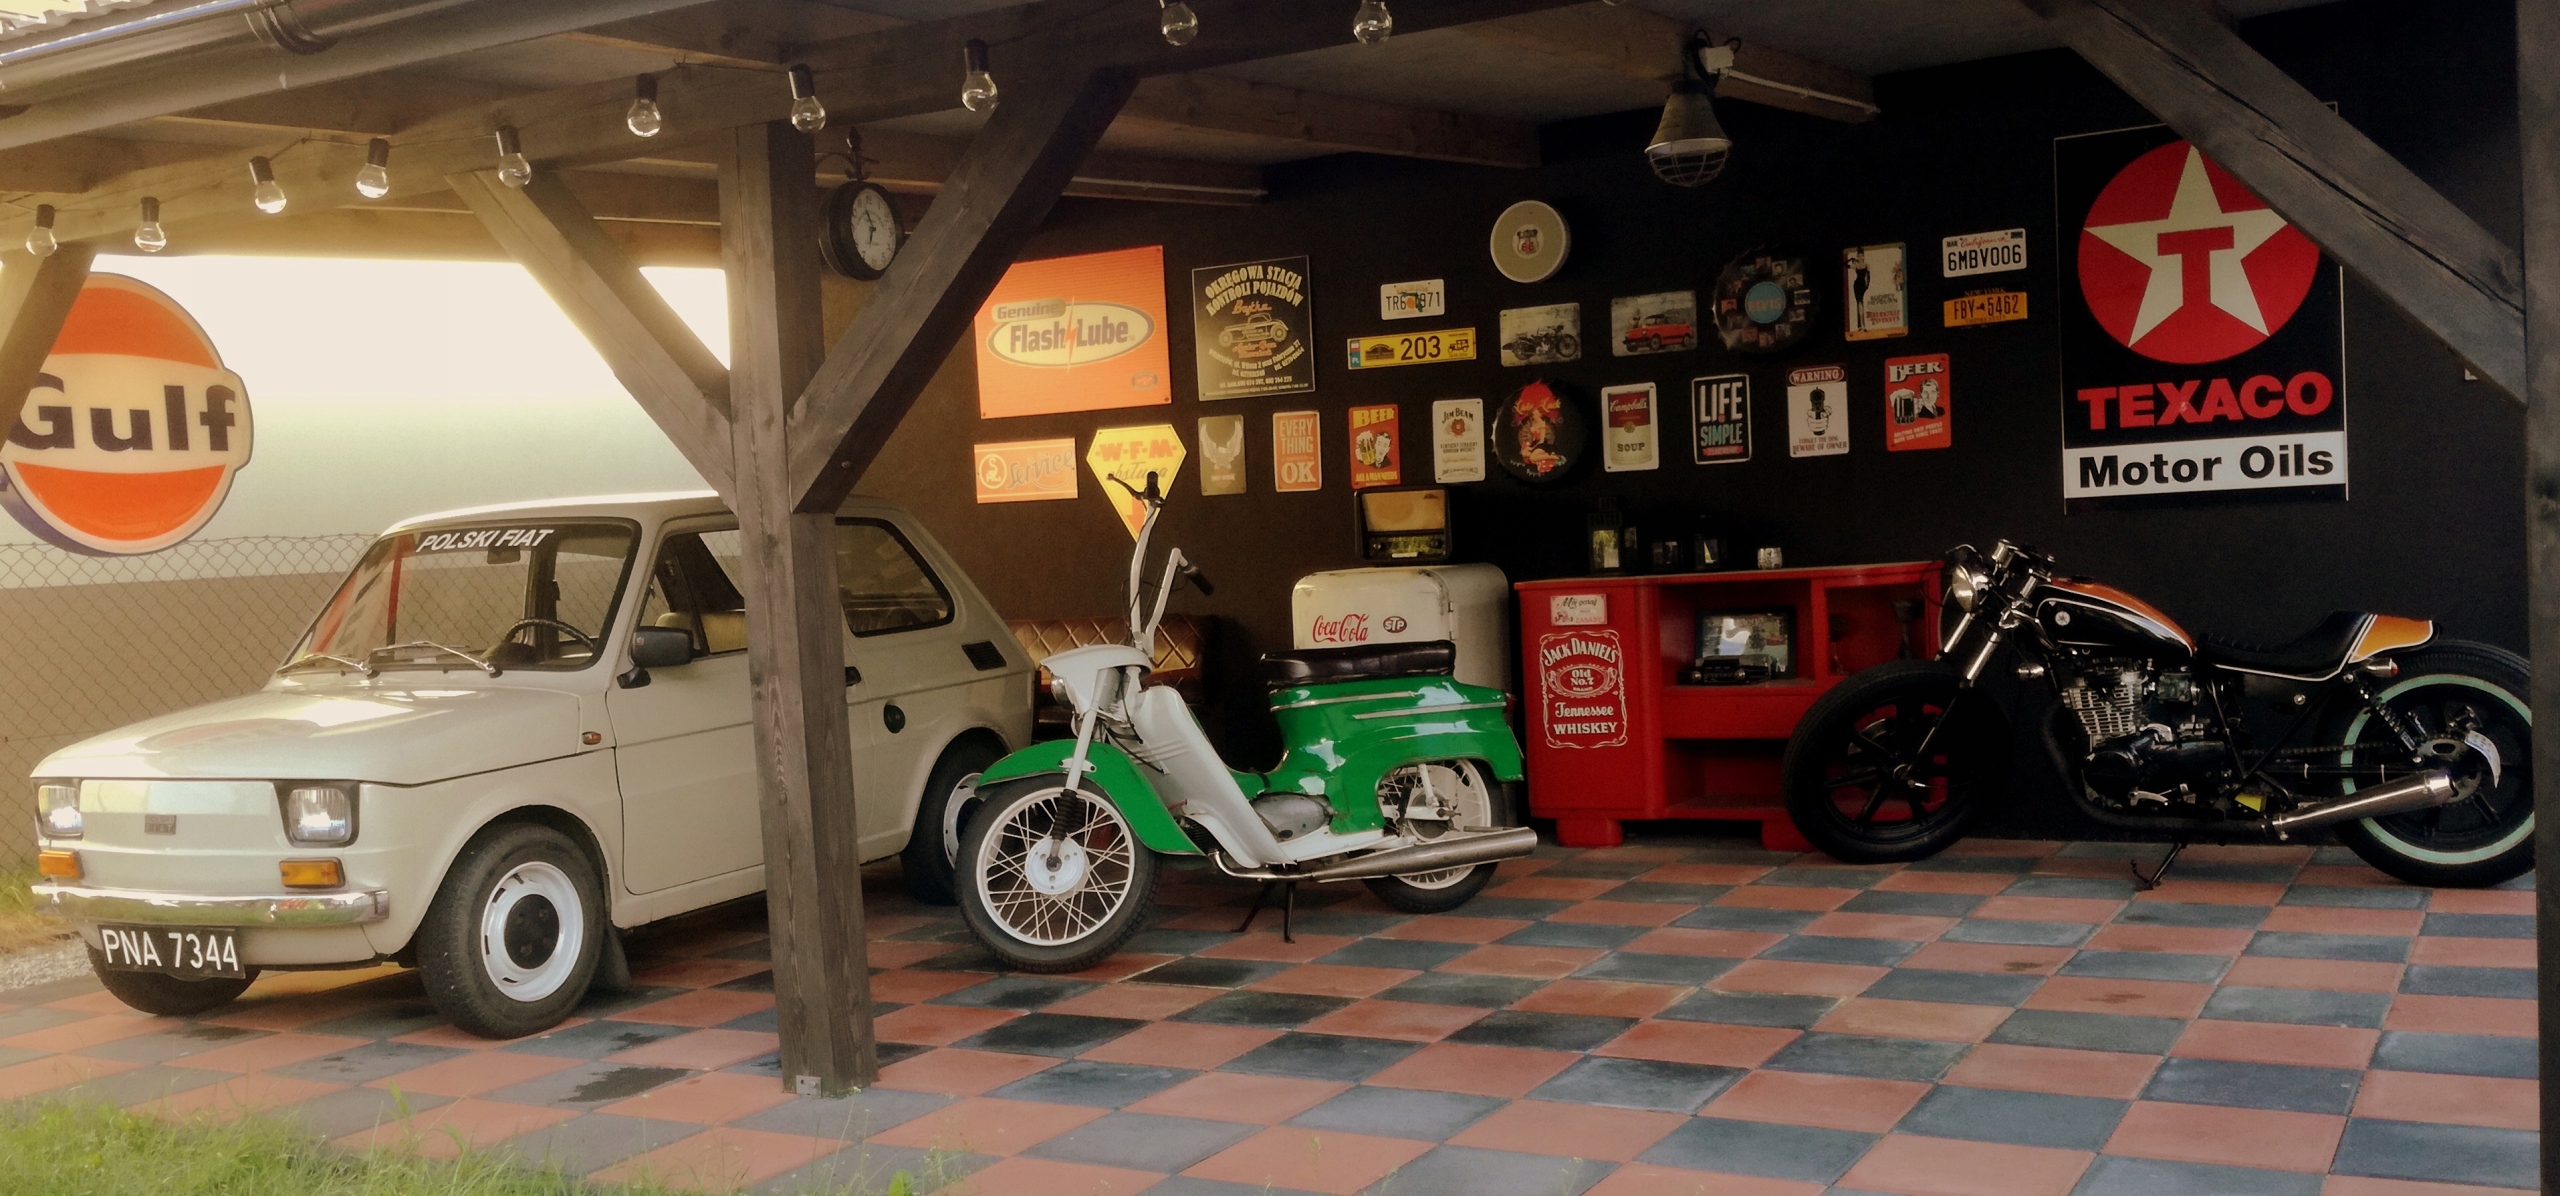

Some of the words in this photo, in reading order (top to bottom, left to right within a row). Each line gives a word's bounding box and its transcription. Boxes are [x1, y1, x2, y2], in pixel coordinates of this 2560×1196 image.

[1948, 244, 2022, 271] 6MBV006
[1205, 265, 1264, 299] OKRĘGOWA
[1267, 265, 1303, 291] STACJA
[997, 302, 1060, 320] Genuine
[1205, 282, 1251, 317] KONTROLI
[1253, 281, 1304, 307] POJAZDÓW
[1953, 299, 1975, 320] FBY
[1987, 294, 2019, 317] 5462
[1400, 335, 1441, 361] 203
[1792, 369, 1840, 383] WARNING
[1889, 361, 1944, 383] BEER
[7, 372, 236, 453] Gulf
[1699, 381, 1743, 423] LIFE
[2077, 371, 2333, 430] TEXACO
[1280, 418, 1314, 437] EVERY
[1353, 408, 1395, 429] BEER
[1441, 409, 1455, 425] JIM
[1455, 407, 1474, 422] BEAM
[1280, 436, 1314, 455] THING
[1617, 442, 1645, 452] SOUP
[1700, 423, 1743, 447] SIMPLE
[1006, 449, 1073, 489] Service
[1281, 461, 1317, 484] OK
[2079, 454, 2222, 489] Motor
[2239, 443, 2334, 479] Oils
[416, 530, 501, 553] POLSKI
[495, 529, 555, 547] FIAT
[1312, 614, 1370, 643] Coca-Cola
[1384, 617, 1405, 631] STP
[1543, 642, 1572, 667] JACK
[1571, 669, 1591, 678] Old
[1555, 702, 1614, 718] Tennessee
[1553, 721, 1618, 735] WHISKEY
[102, 929, 162, 967] PNA
[168, 932, 239, 972] 7344
